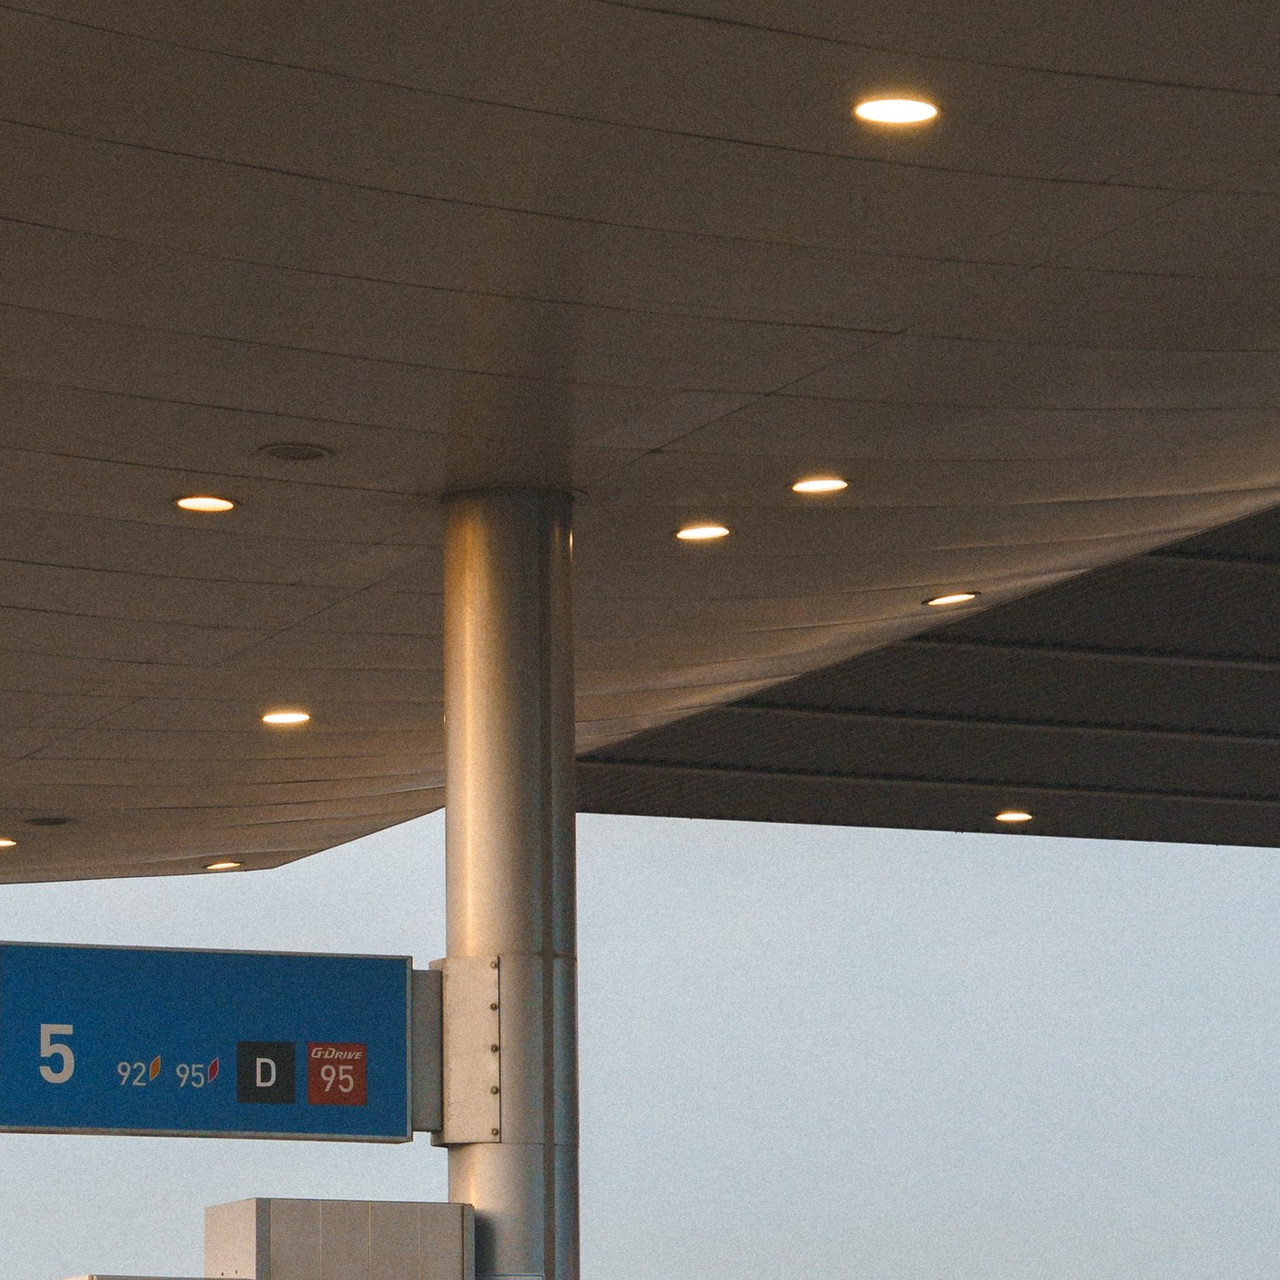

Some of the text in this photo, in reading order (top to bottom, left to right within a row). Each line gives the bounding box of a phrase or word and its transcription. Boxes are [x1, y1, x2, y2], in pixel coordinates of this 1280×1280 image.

[39, 1023, 75, 1084] 5
[117, 1061, 147, 1086] 92
[176, 1063, 205, 1088] 95
[255, 1057, 277, 1088] D
[320, 1064, 355, 1093] 95
